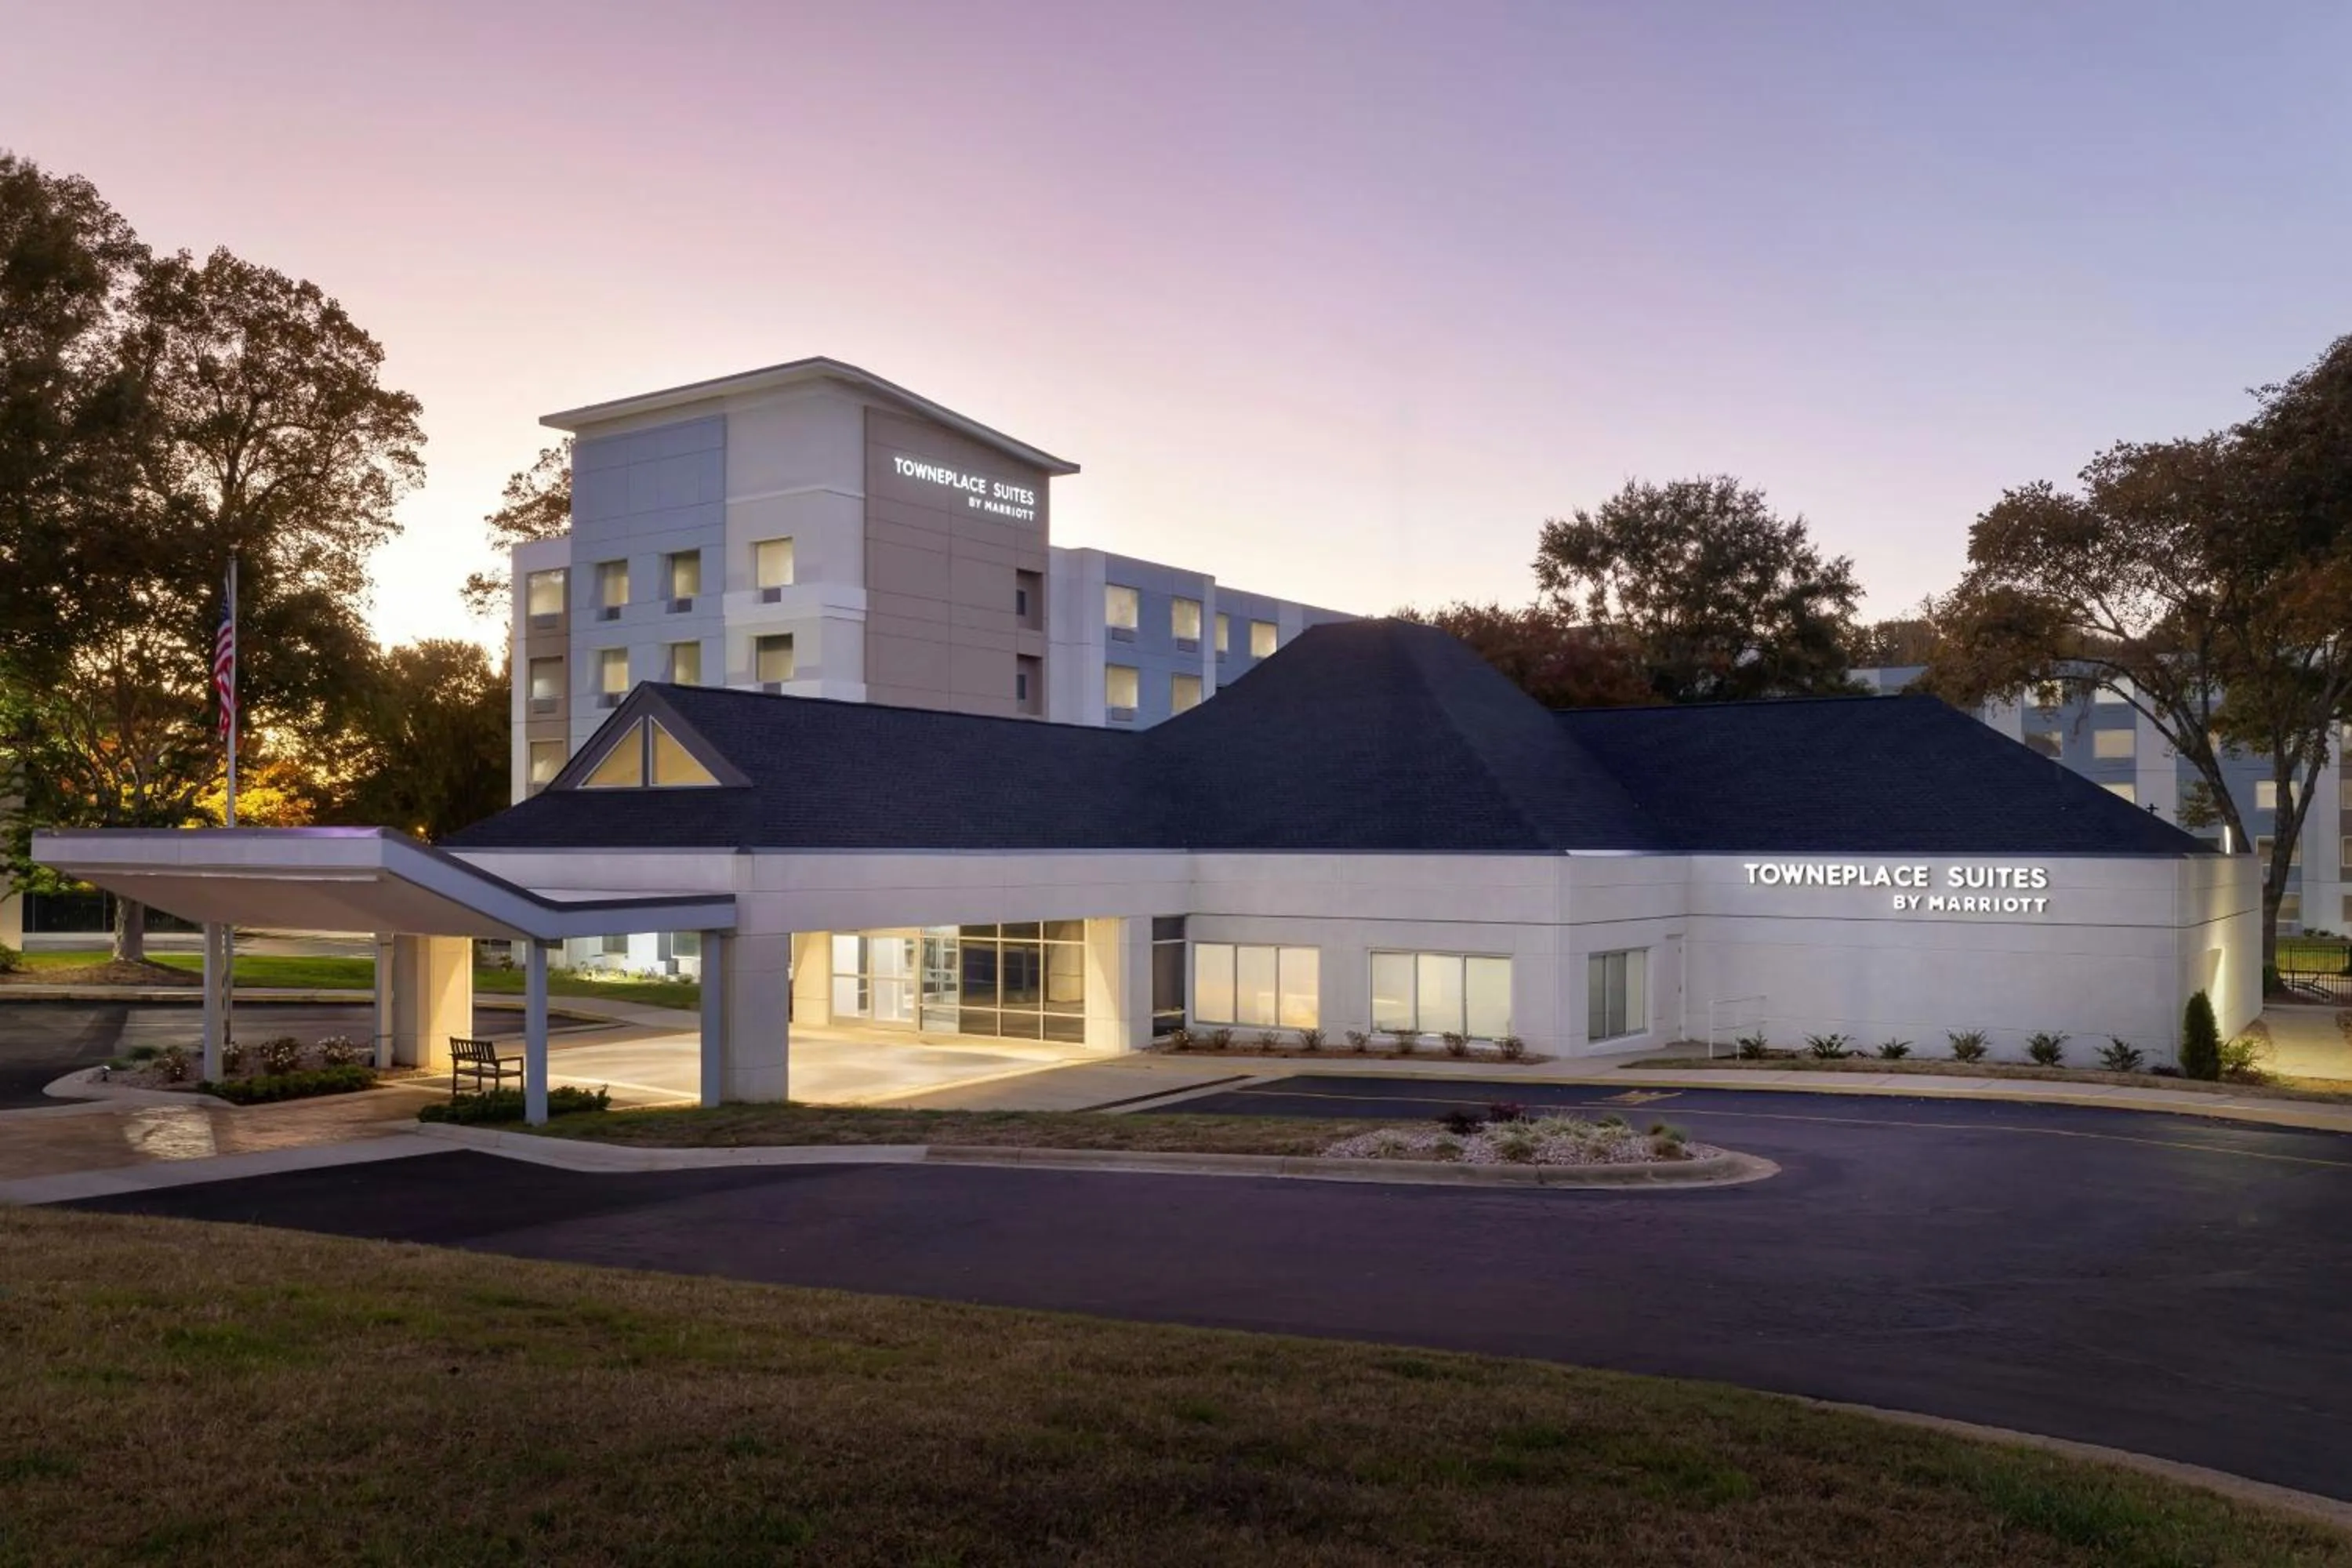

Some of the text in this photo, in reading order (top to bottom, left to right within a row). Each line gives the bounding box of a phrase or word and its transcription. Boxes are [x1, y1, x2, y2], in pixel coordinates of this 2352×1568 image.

[894, 457, 1035, 506] TOWNEPLACE SUITES
[968, 496, 1035, 521] BY MARRIOTT
[1744, 863, 2048, 888] TOWNEPLACE SUITES
[1893, 895, 2048, 913] BY MARRIOTT
